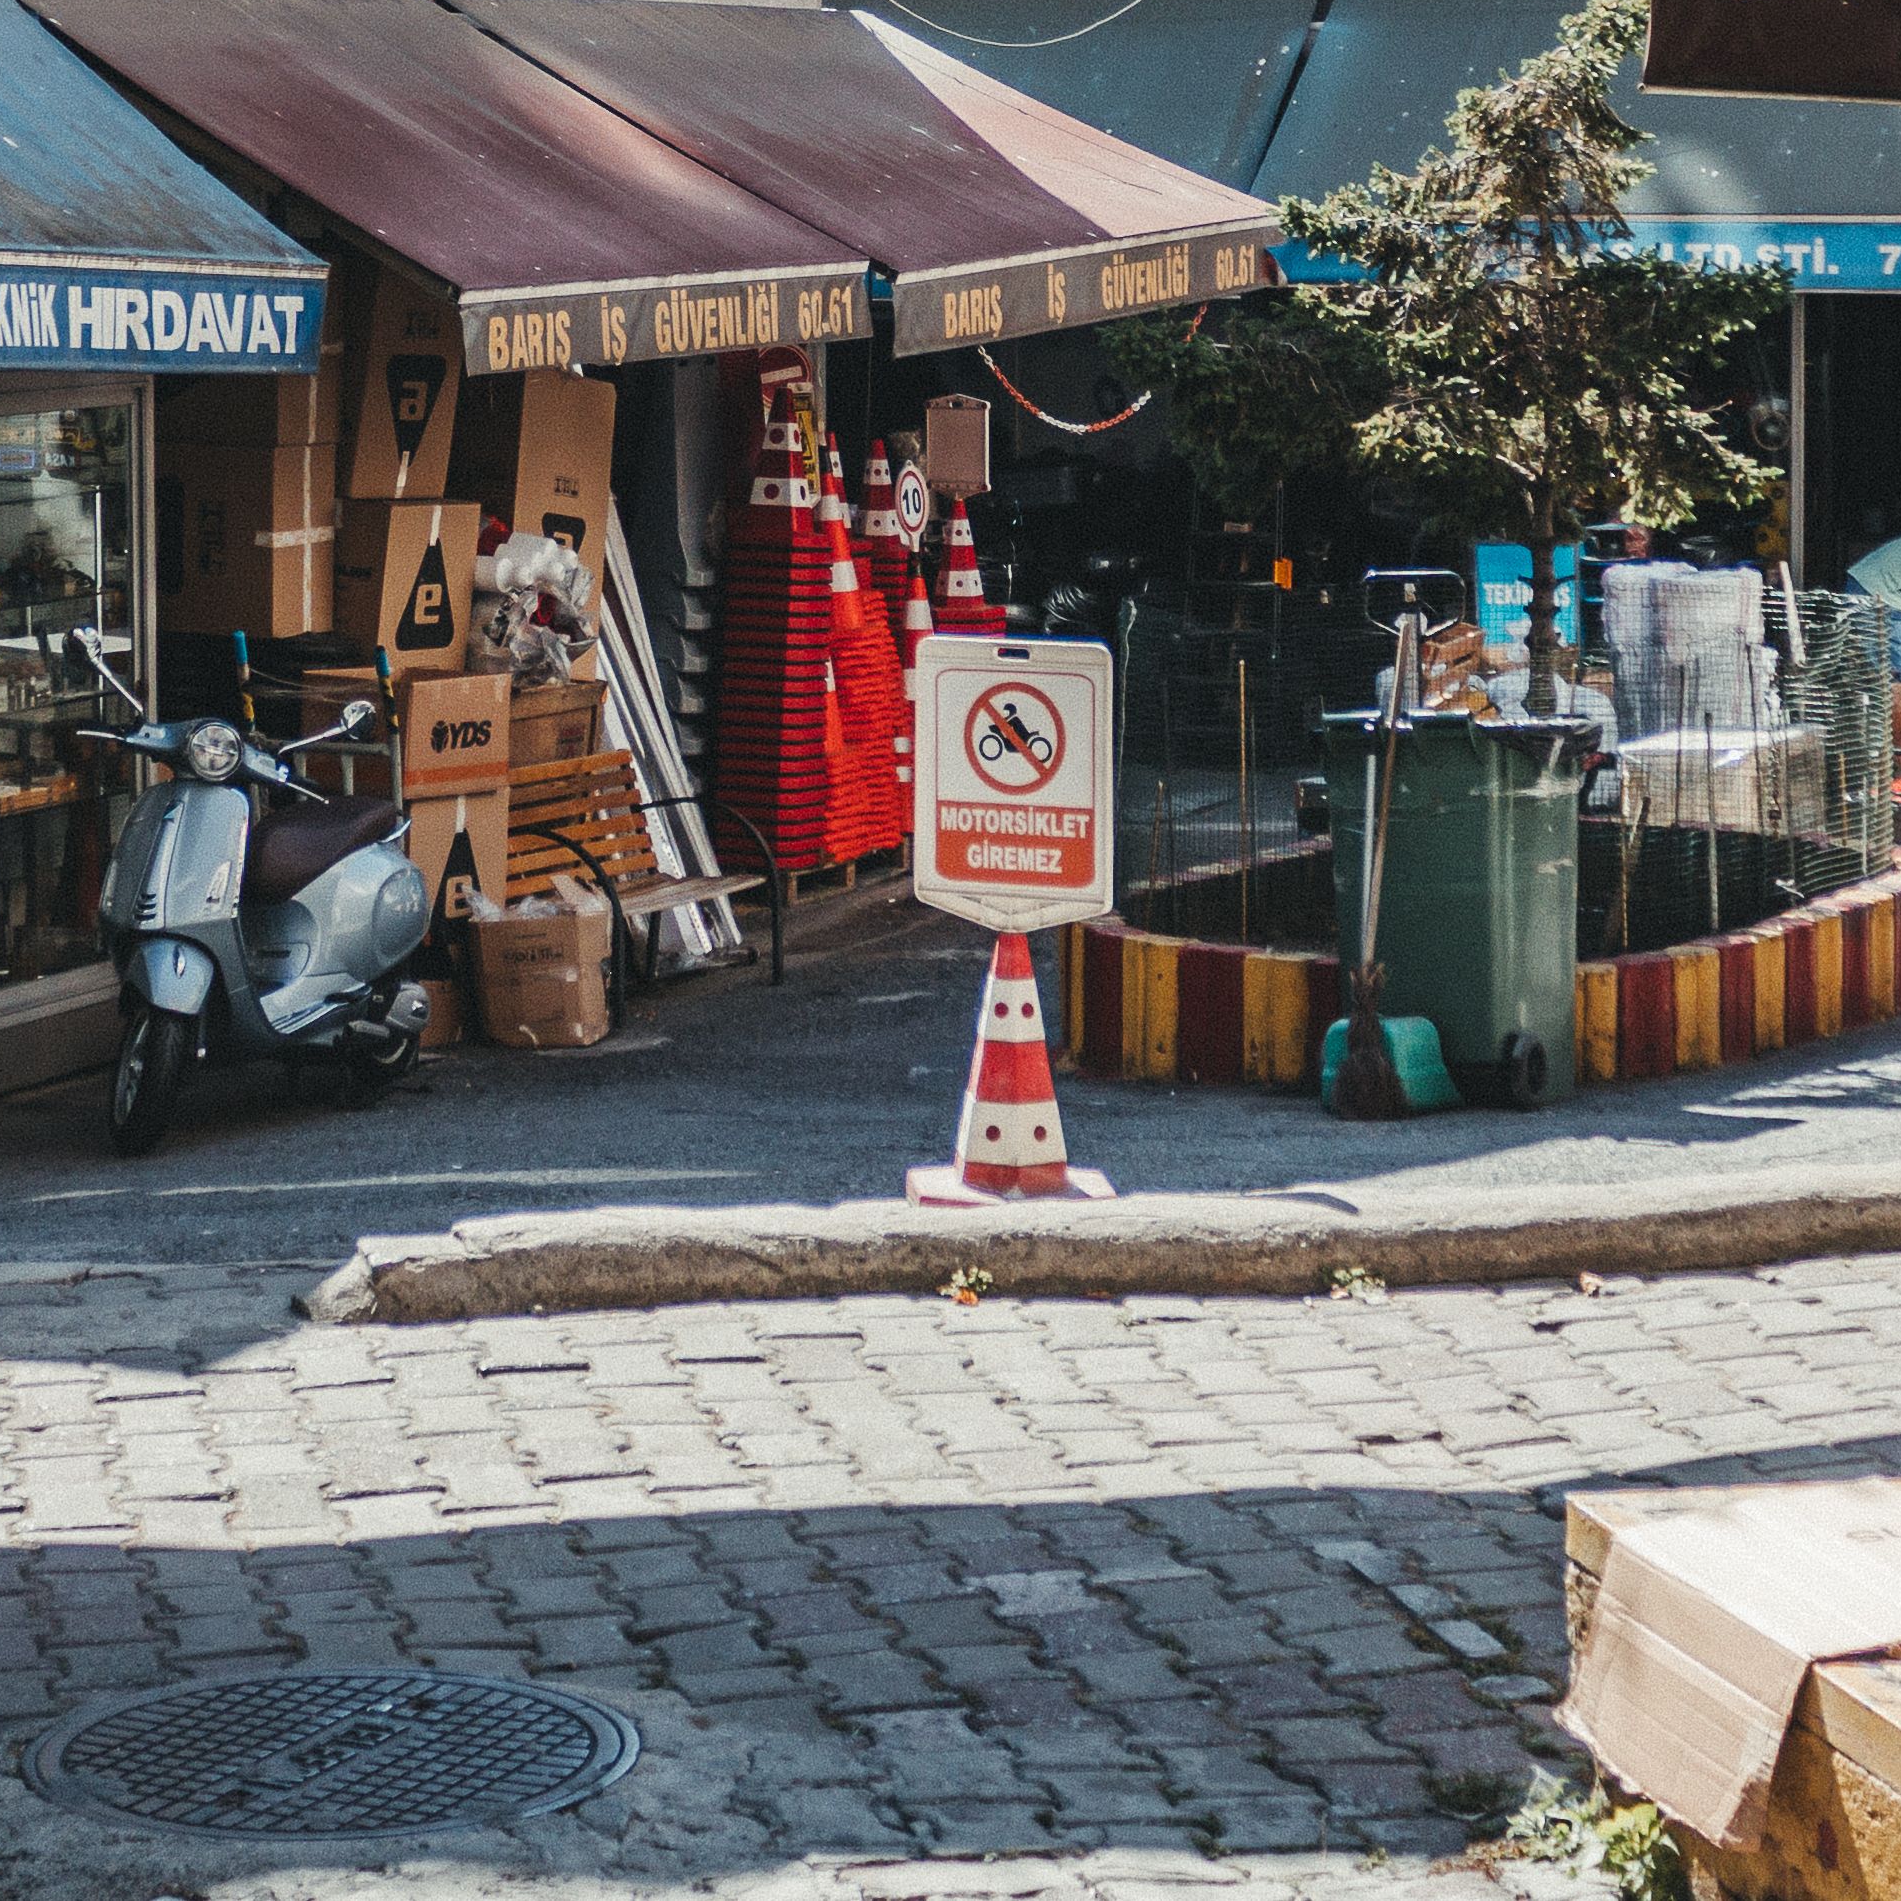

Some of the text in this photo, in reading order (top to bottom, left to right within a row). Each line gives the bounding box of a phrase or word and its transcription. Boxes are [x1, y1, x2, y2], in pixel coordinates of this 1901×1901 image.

[944, 284, 1003, 339] BARIŞ
[1047, 262, 1067, 325] İŞ
[1101, 242, 1192, 312] GÜVENLİĞİ
[67, 285, 304, 355] HIRDAVAT
[488, 309, 572, 371] BARIŞ
[601, 295, 628, 366] İŞ
[654, 281, 780, 354] GÜVENLİĞİ
[902, 487, 922, 515] 10
[450, 720, 492, 750] YDS
[940, 805, 1091, 839] MOTORSİKLET
[967, 839, 1063, 874] GİREMEZ
